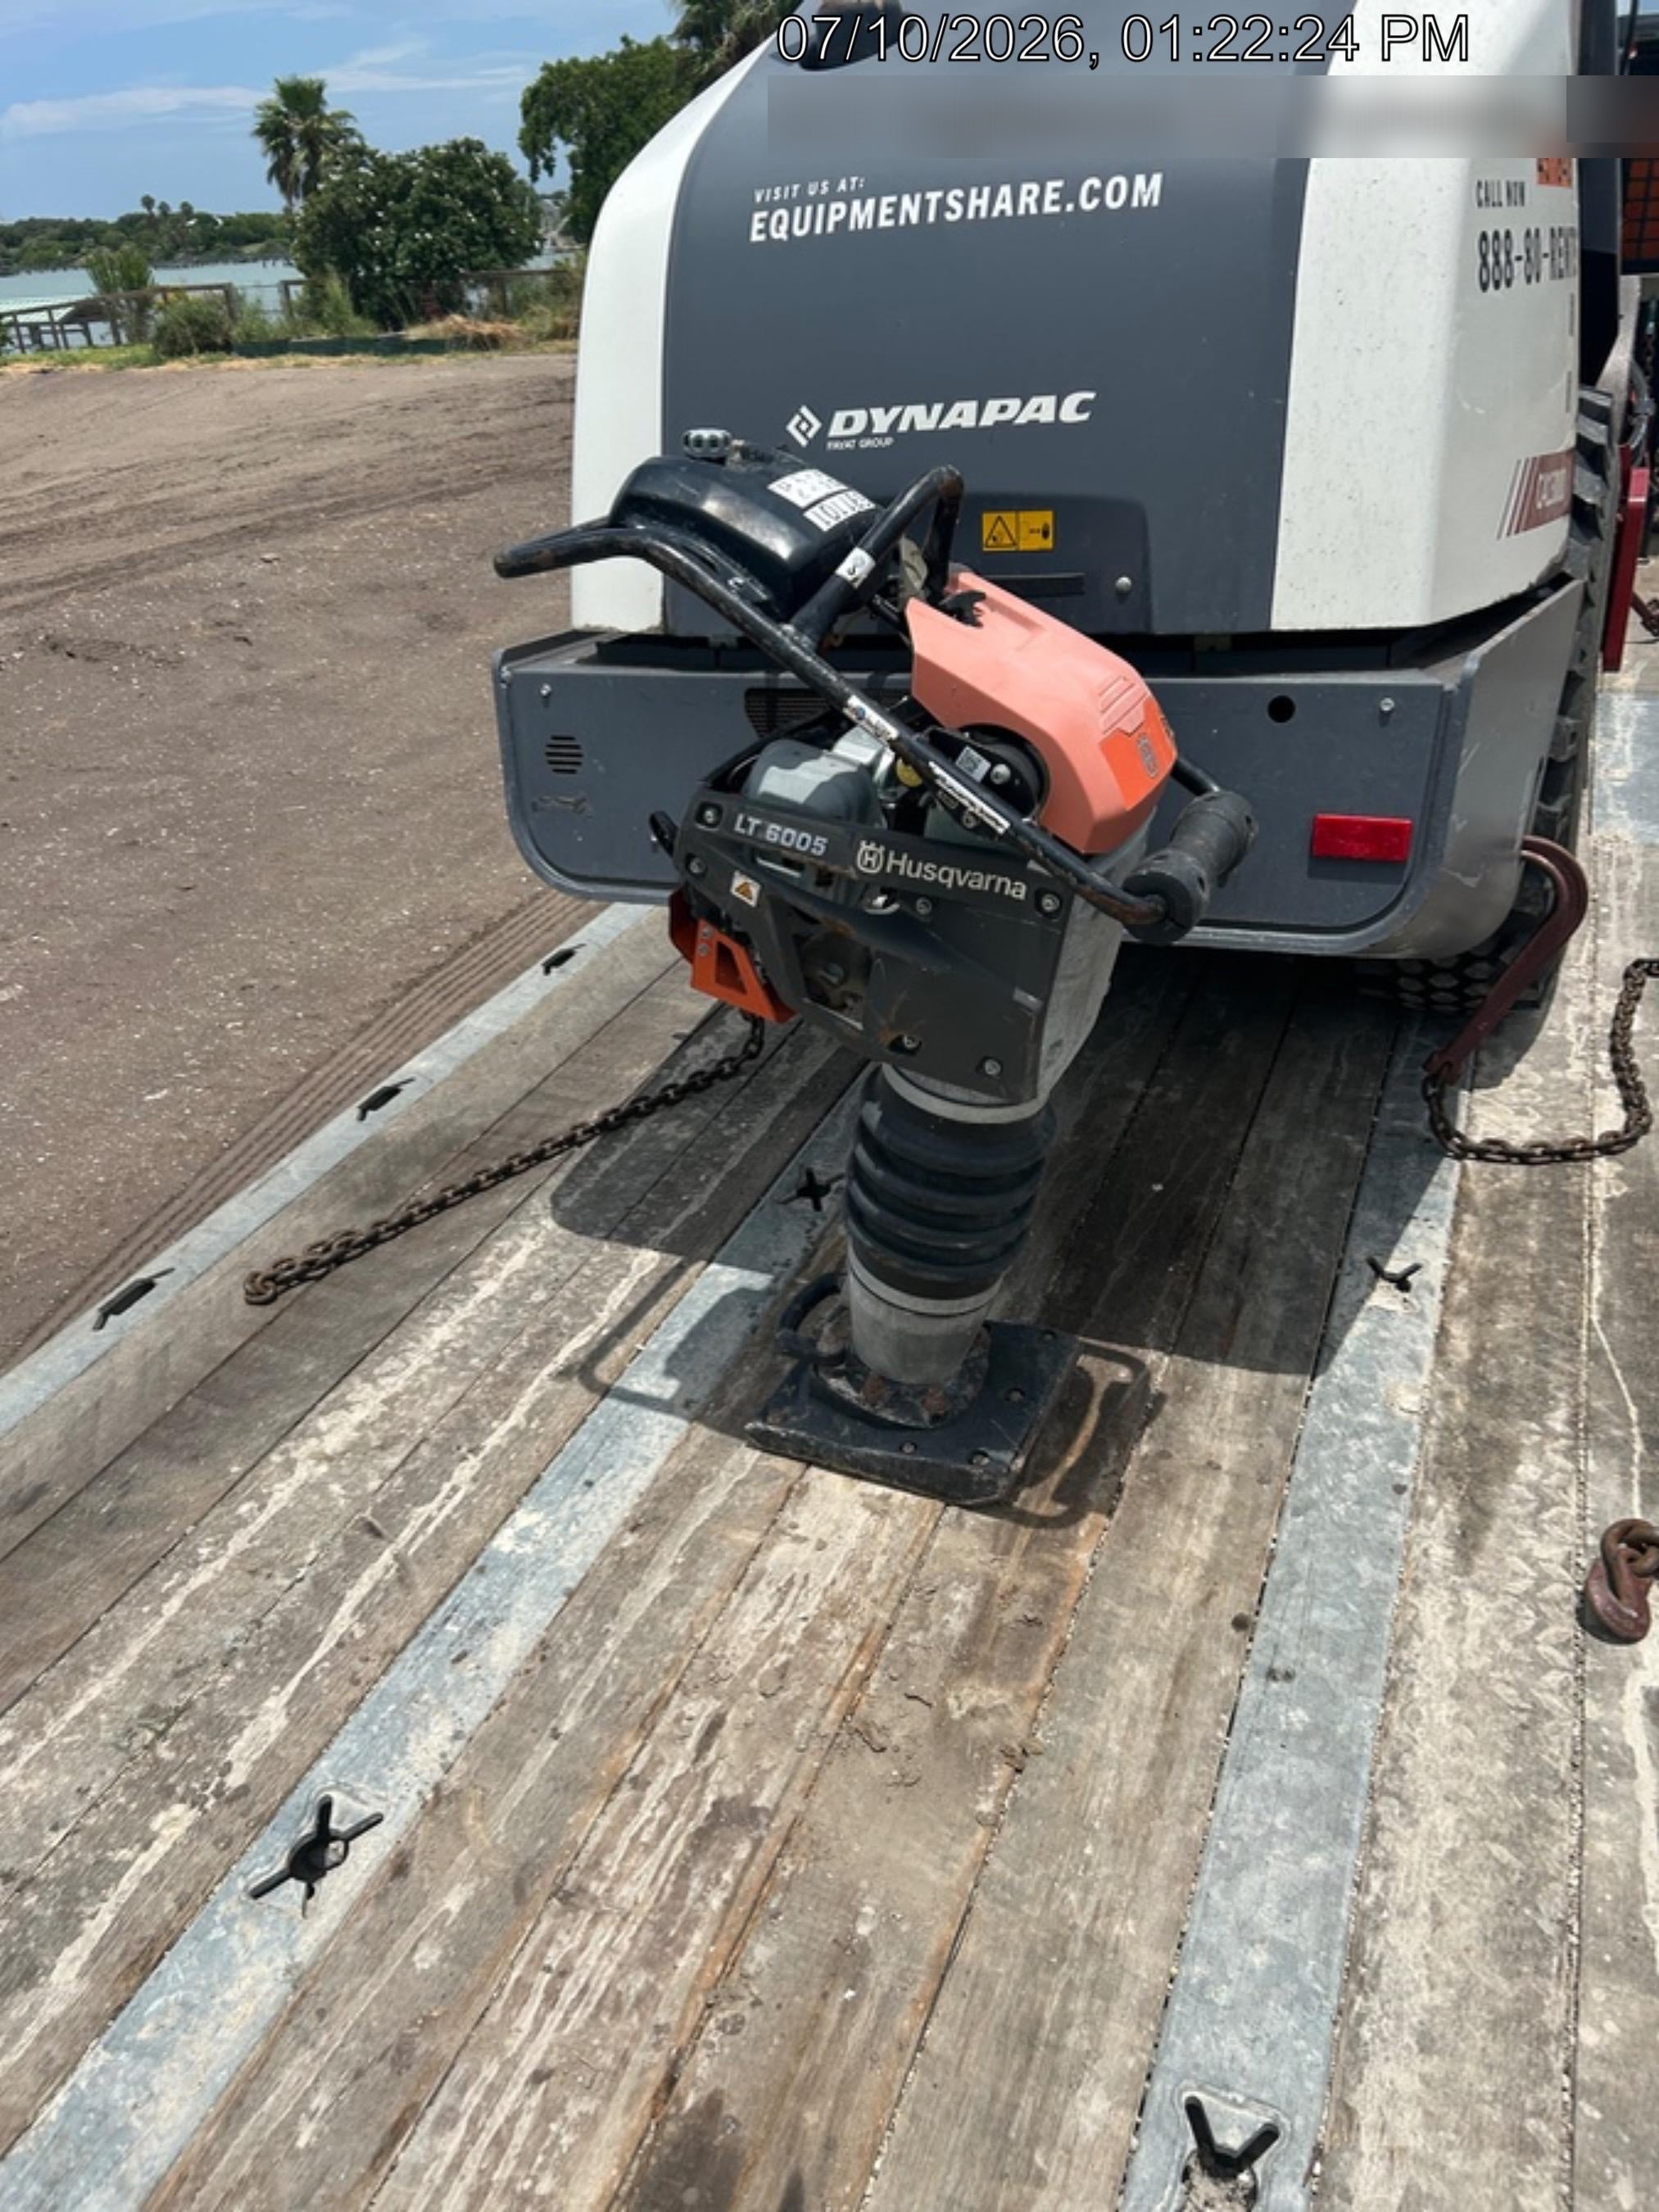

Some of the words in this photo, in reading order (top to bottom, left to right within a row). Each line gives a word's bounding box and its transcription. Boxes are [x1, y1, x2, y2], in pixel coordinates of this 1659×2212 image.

[750, 171, 1163, 243] EQUIPMENTSHARE.COM
[754, 184, 801, 203] VISIT
[807, 179, 830, 197] US
[836, 175, 866, 193] AT:
[1476, 179, 1503, 208] CALL
[827, 390, 1097, 438] DYNAPAC
[859, 436, 895, 449] GROUP
[734, 813, 762, 836] LT
[765, 822, 829, 856] 6005
[886, 849, 1028, 900] Husqvarna
